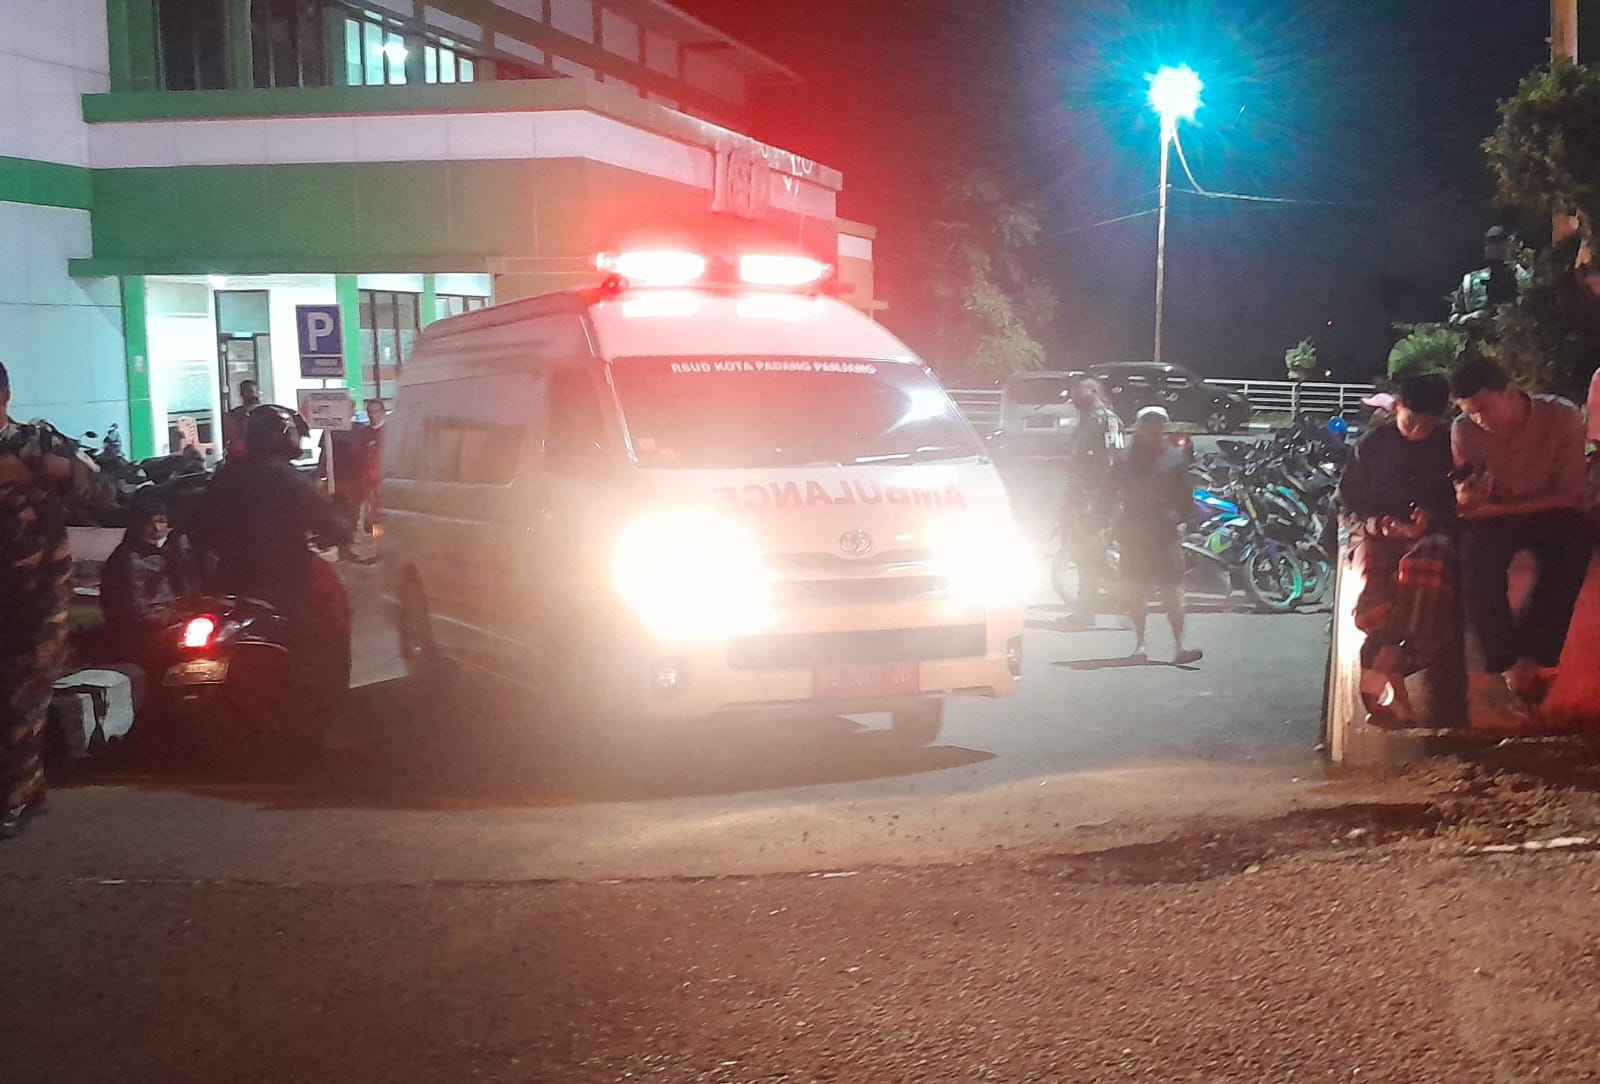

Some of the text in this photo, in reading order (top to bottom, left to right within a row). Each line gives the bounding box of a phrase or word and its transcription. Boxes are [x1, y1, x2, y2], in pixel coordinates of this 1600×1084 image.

[307, 312, 334, 352] P
[671, 361, 711, 373] RSUD
[714, 360, 753, 372] KOTA
